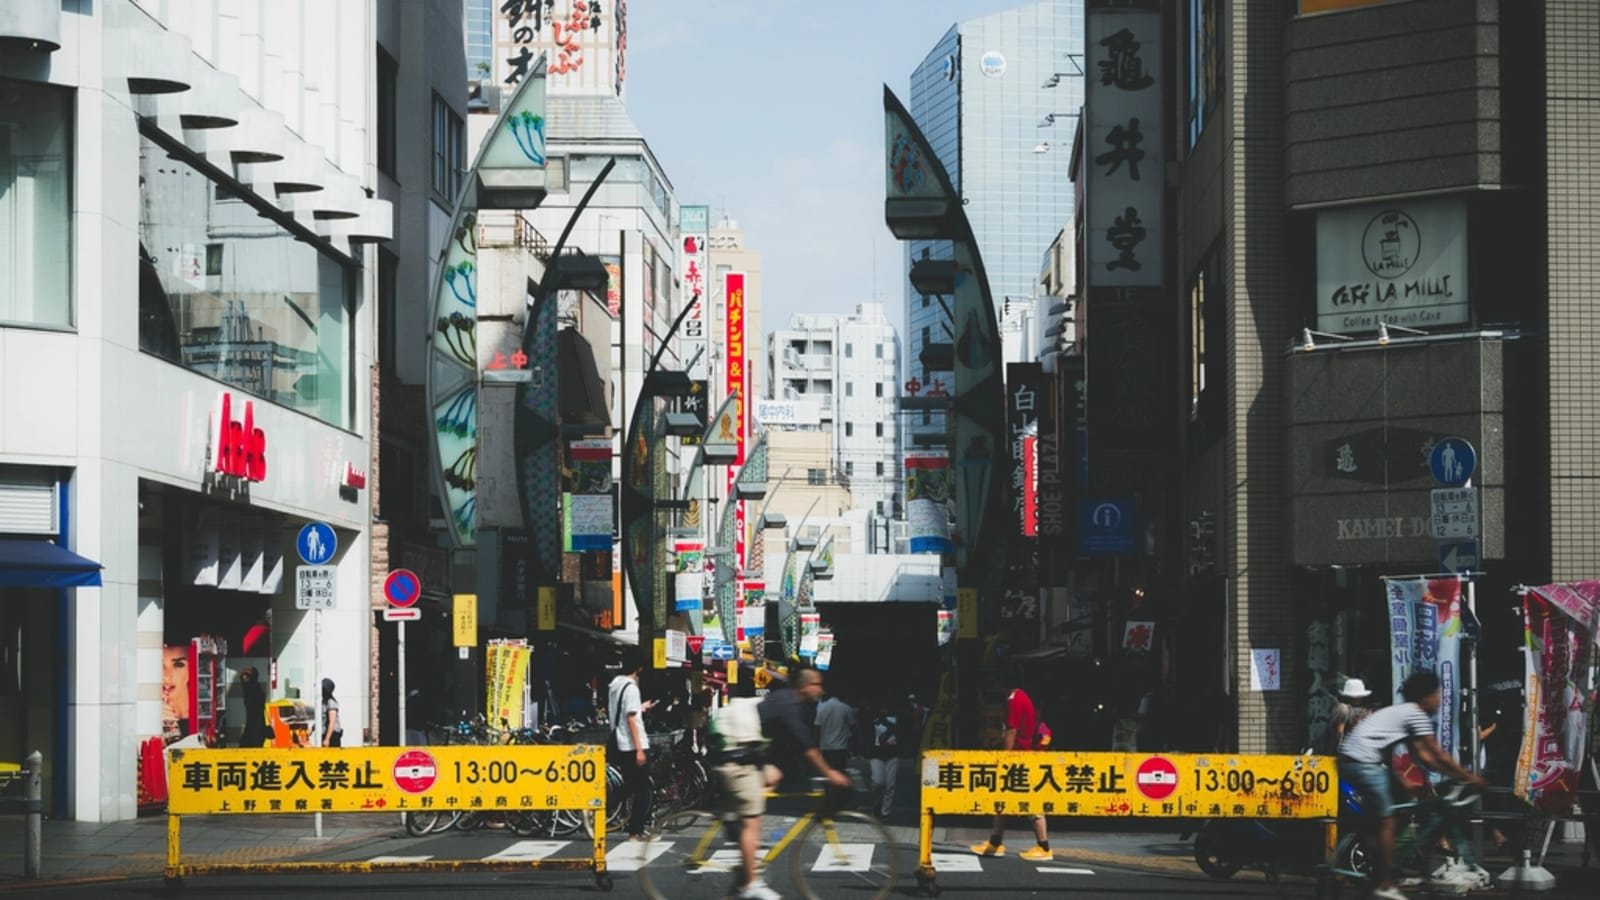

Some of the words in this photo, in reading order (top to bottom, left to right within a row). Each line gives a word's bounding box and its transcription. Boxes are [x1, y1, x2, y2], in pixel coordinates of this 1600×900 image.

[1376, 281, 1398, 304] LA
[182, 759, 384, 792] 車両進入禁止
[937, 762, 1127, 795] 車両進入禁止
[396, 794, 560, 810] 上野中通商店街
[1137, 801, 1294, 817] 上野中通商店街
